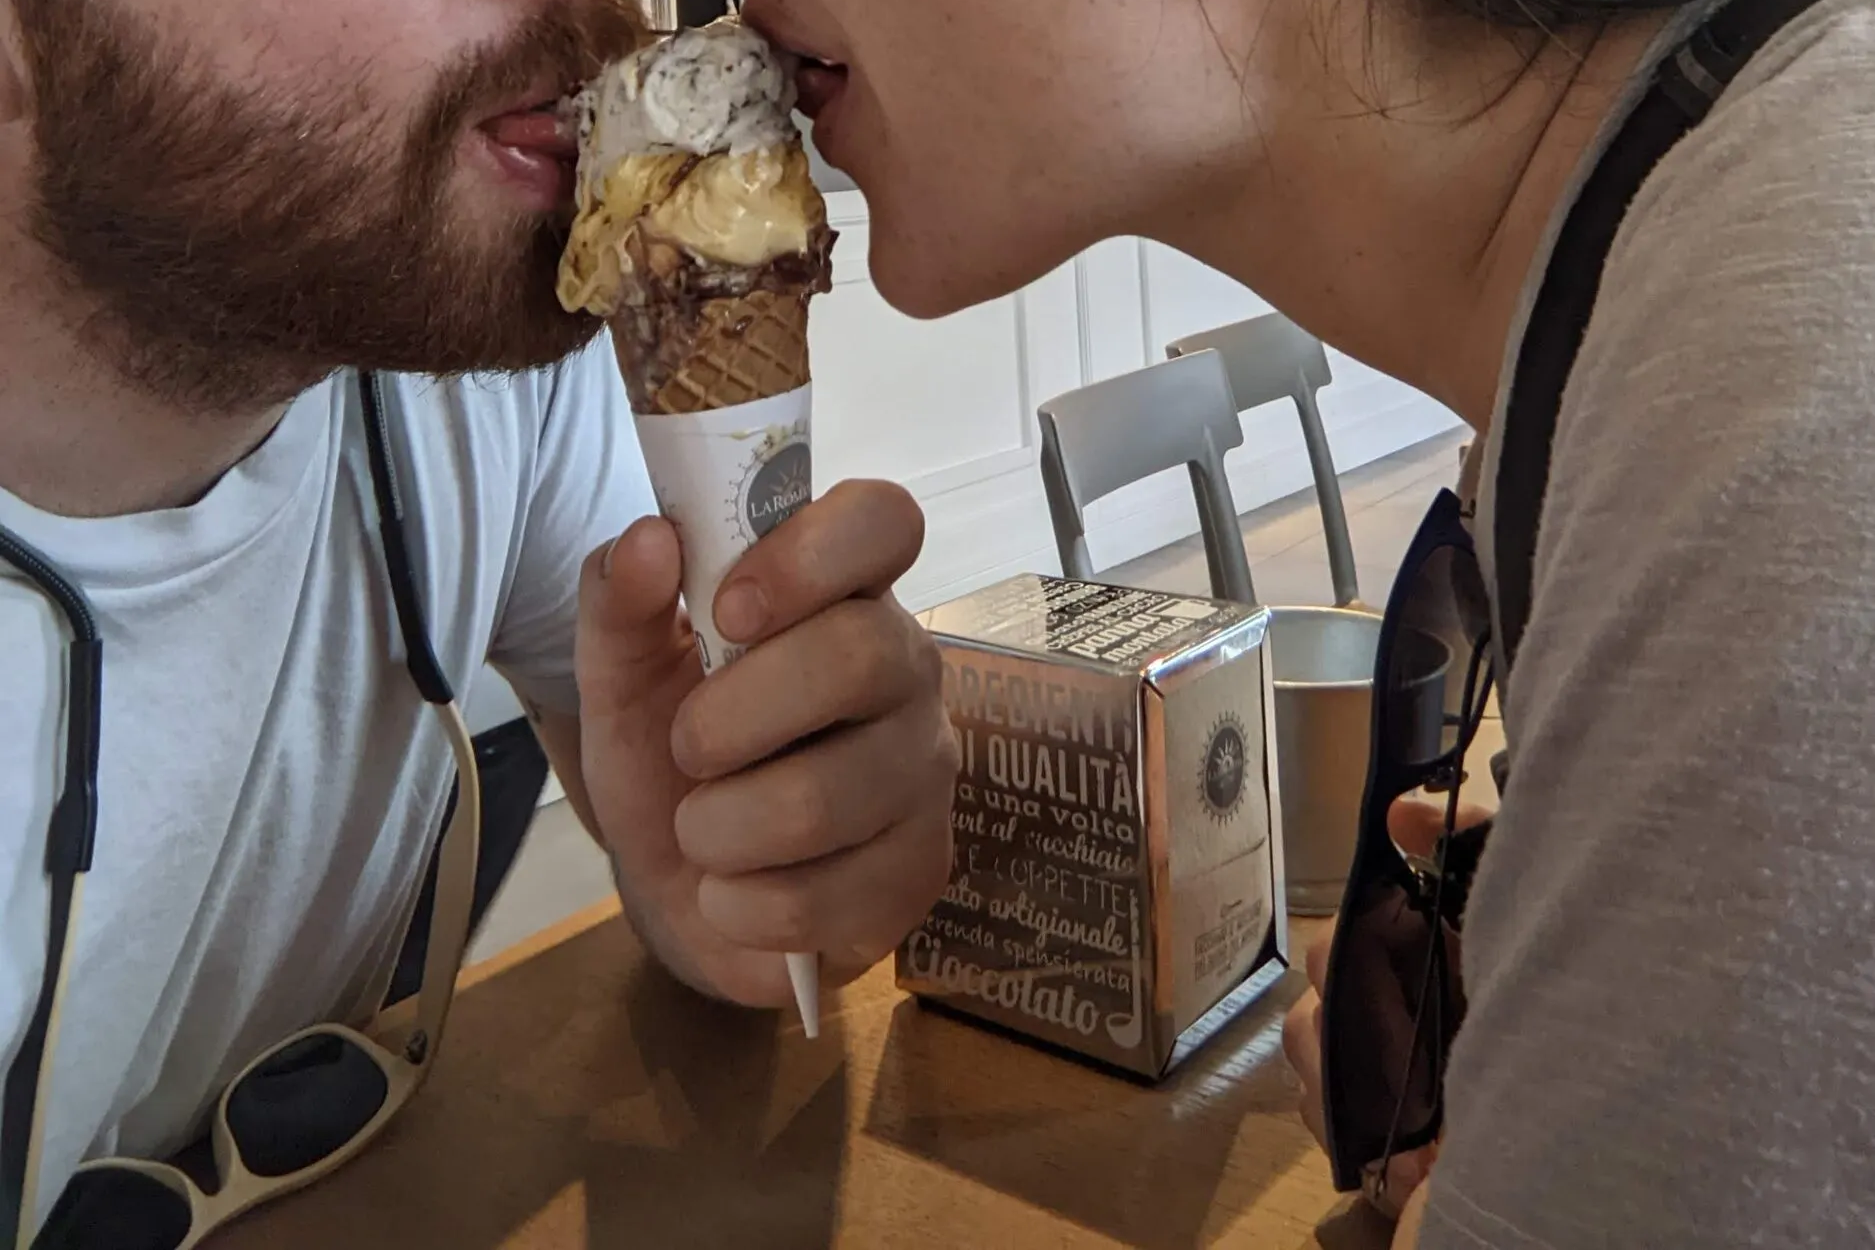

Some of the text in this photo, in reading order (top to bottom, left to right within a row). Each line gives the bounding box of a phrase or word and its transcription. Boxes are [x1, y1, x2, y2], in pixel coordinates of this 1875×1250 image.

[1068, 614, 1161, 660] panna
[1102, 617, 1195, 662] montata
[988, 734, 1133, 817] QUALITÀ
[984, 788, 1041, 819] una
[1050, 806, 1136, 843] volta
[926, 916, 1131, 993] erenda spensierata
[989, 891, 1128, 955] artigianale
[908, 930, 1101, 1035] Cioccolato
